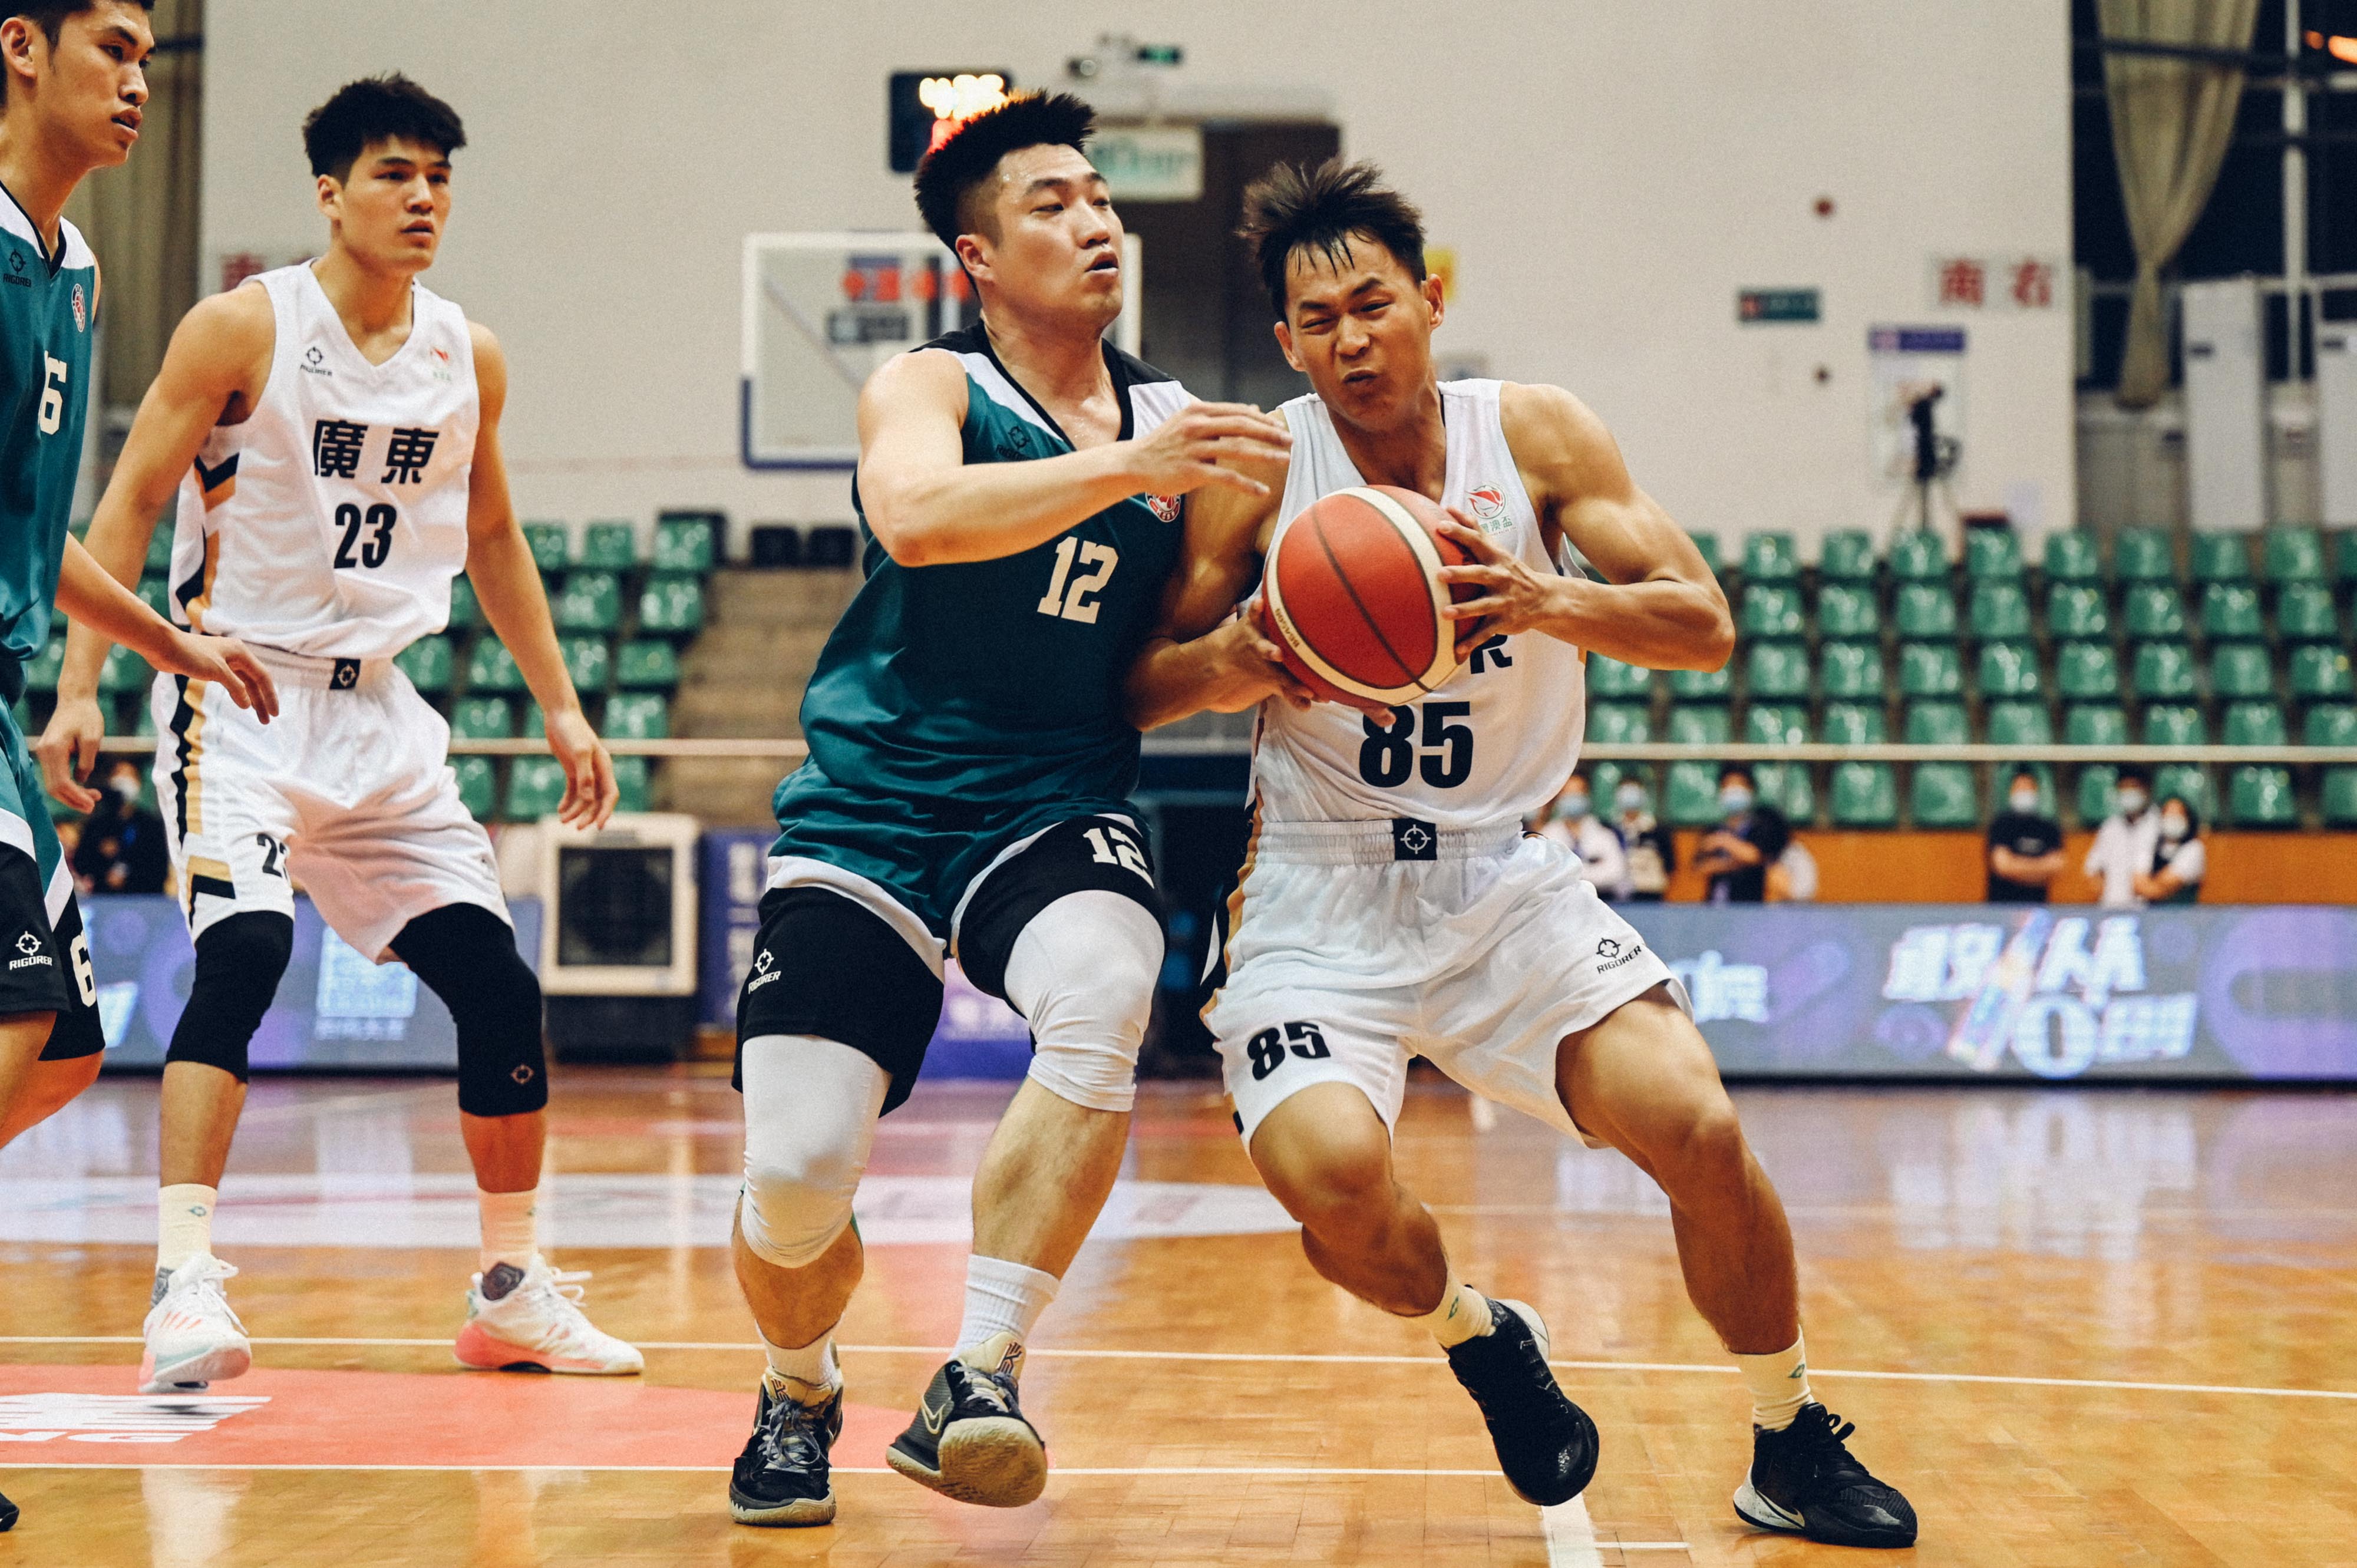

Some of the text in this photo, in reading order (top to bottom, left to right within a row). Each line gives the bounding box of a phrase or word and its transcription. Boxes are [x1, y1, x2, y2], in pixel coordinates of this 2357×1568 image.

[38, 350, 67, 435] 6
[313, 420, 440, 484] 廣東
[334, 503, 397, 569] 23
[1037, 536, 1119, 625] 12
[1359, 701, 1474, 788] 85
[1082, 826, 1155, 890] 12
[9, 955, 53, 970] RIGORER
[70, 929, 97, 1008] 6
[748, 970, 782, 995] RIGORER
[1596, 945, 1642, 975] RIGORER
[1247, 1021, 1332, 1087] 85
